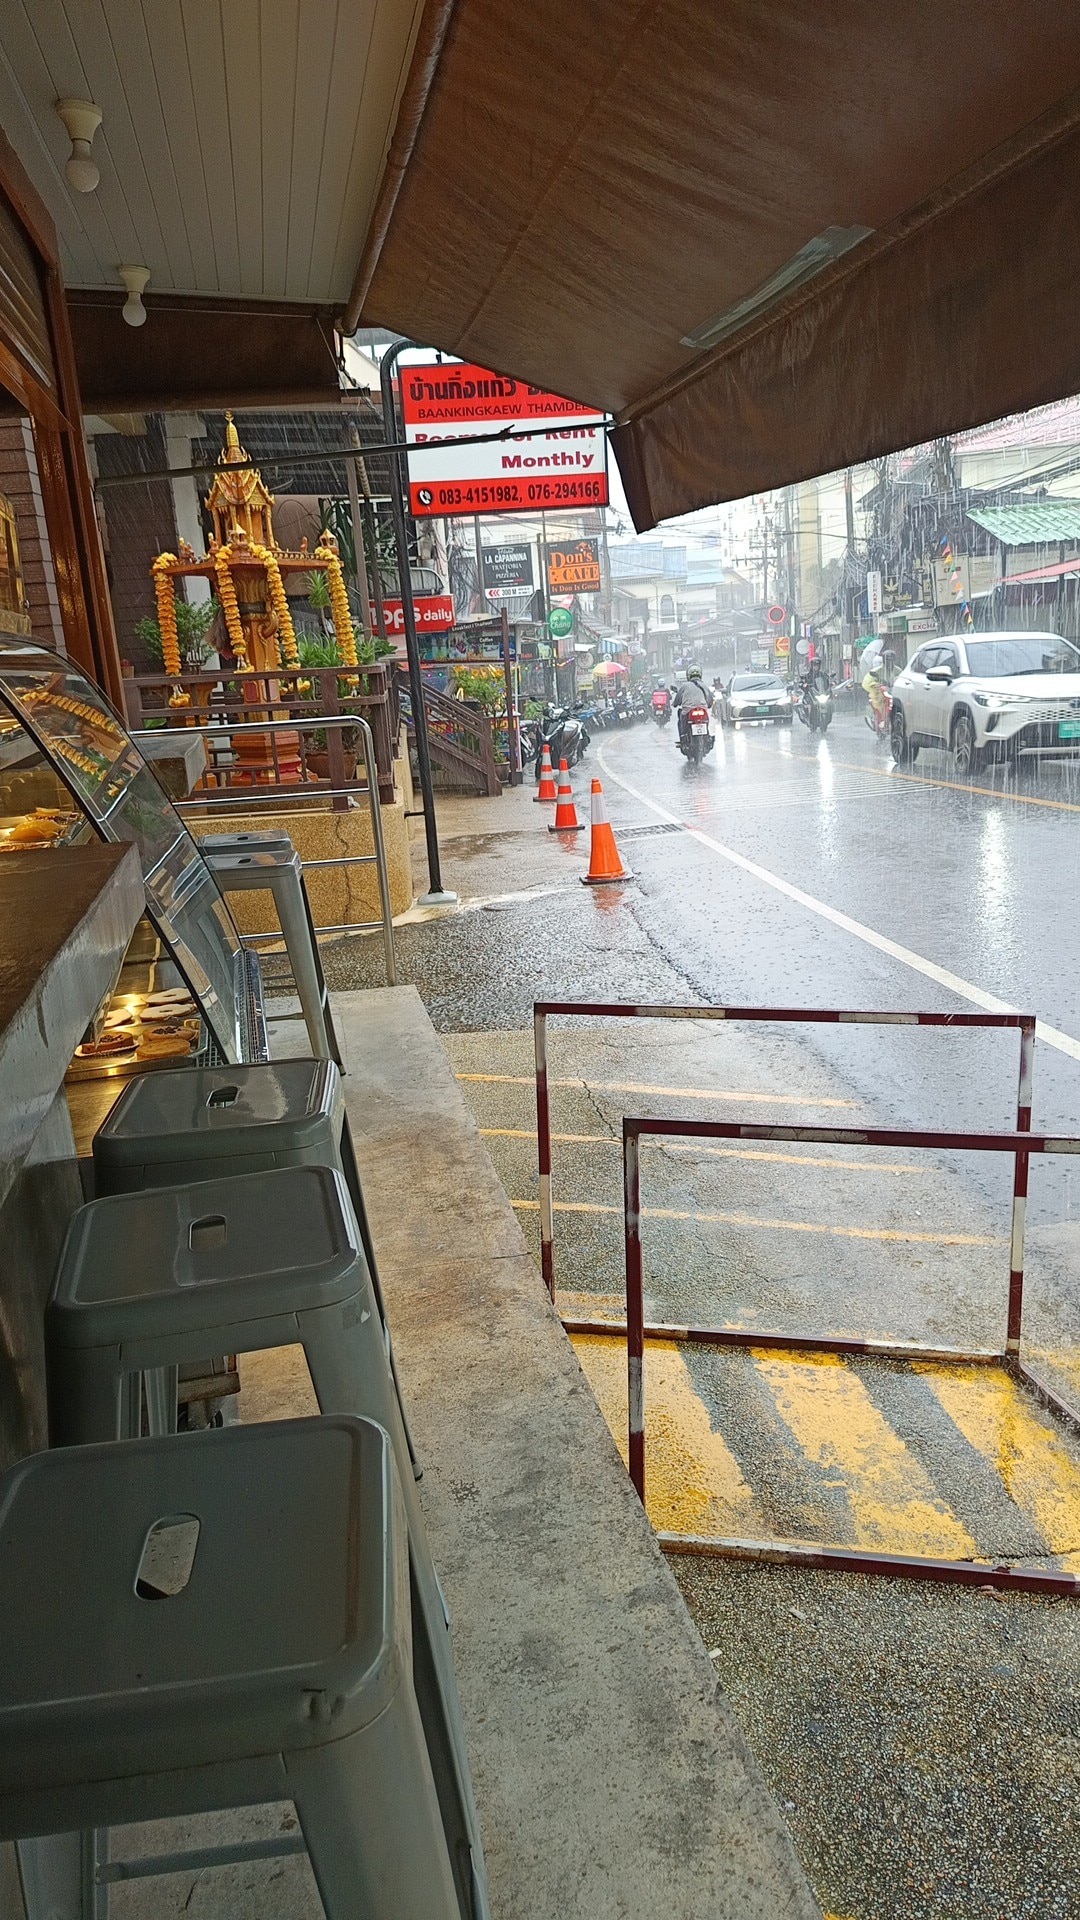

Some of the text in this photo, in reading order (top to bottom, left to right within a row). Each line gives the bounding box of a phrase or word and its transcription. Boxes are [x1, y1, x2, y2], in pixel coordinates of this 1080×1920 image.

[418, 404, 522, 419] BAANKINGKAEW
[501, 451, 595, 468] Monthly
[439, 480, 600, 505] 083-4151982, 076-294166
[484, 552, 528, 564] LA CAPANNINA
[550, 551, 593, 569] Don's
[562, 567, 599, 581] CAFE
[581, 582, 599, 590] Good
[423, 608, 453, 622] daily
[551, 621, 571, 630] Chang
